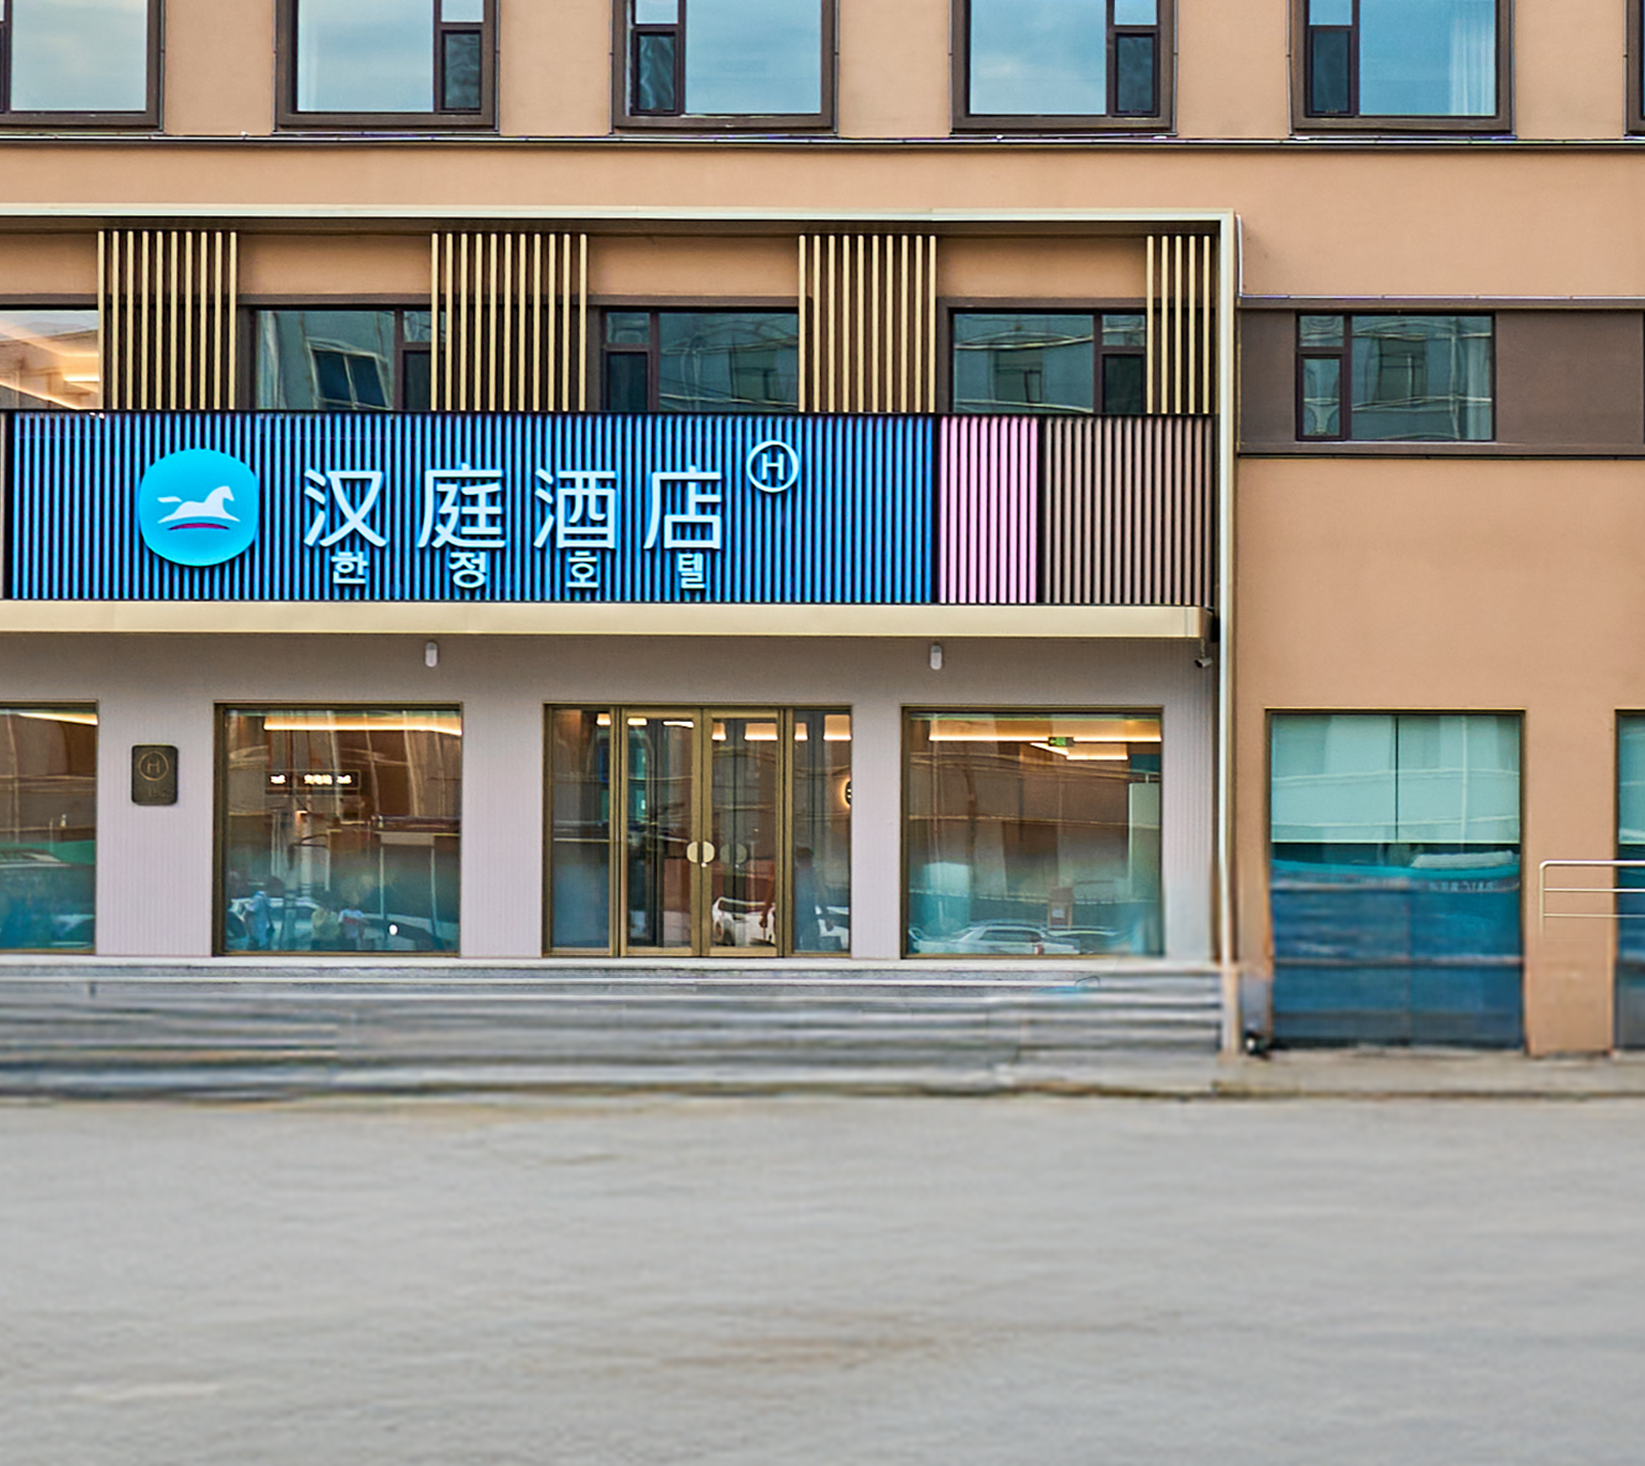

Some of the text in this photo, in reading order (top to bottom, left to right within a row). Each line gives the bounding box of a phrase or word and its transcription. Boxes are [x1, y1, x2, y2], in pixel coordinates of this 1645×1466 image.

[303, 462, 723, 550] 汉庭酒店
[329, 551, 707, 589] 한정호텔
